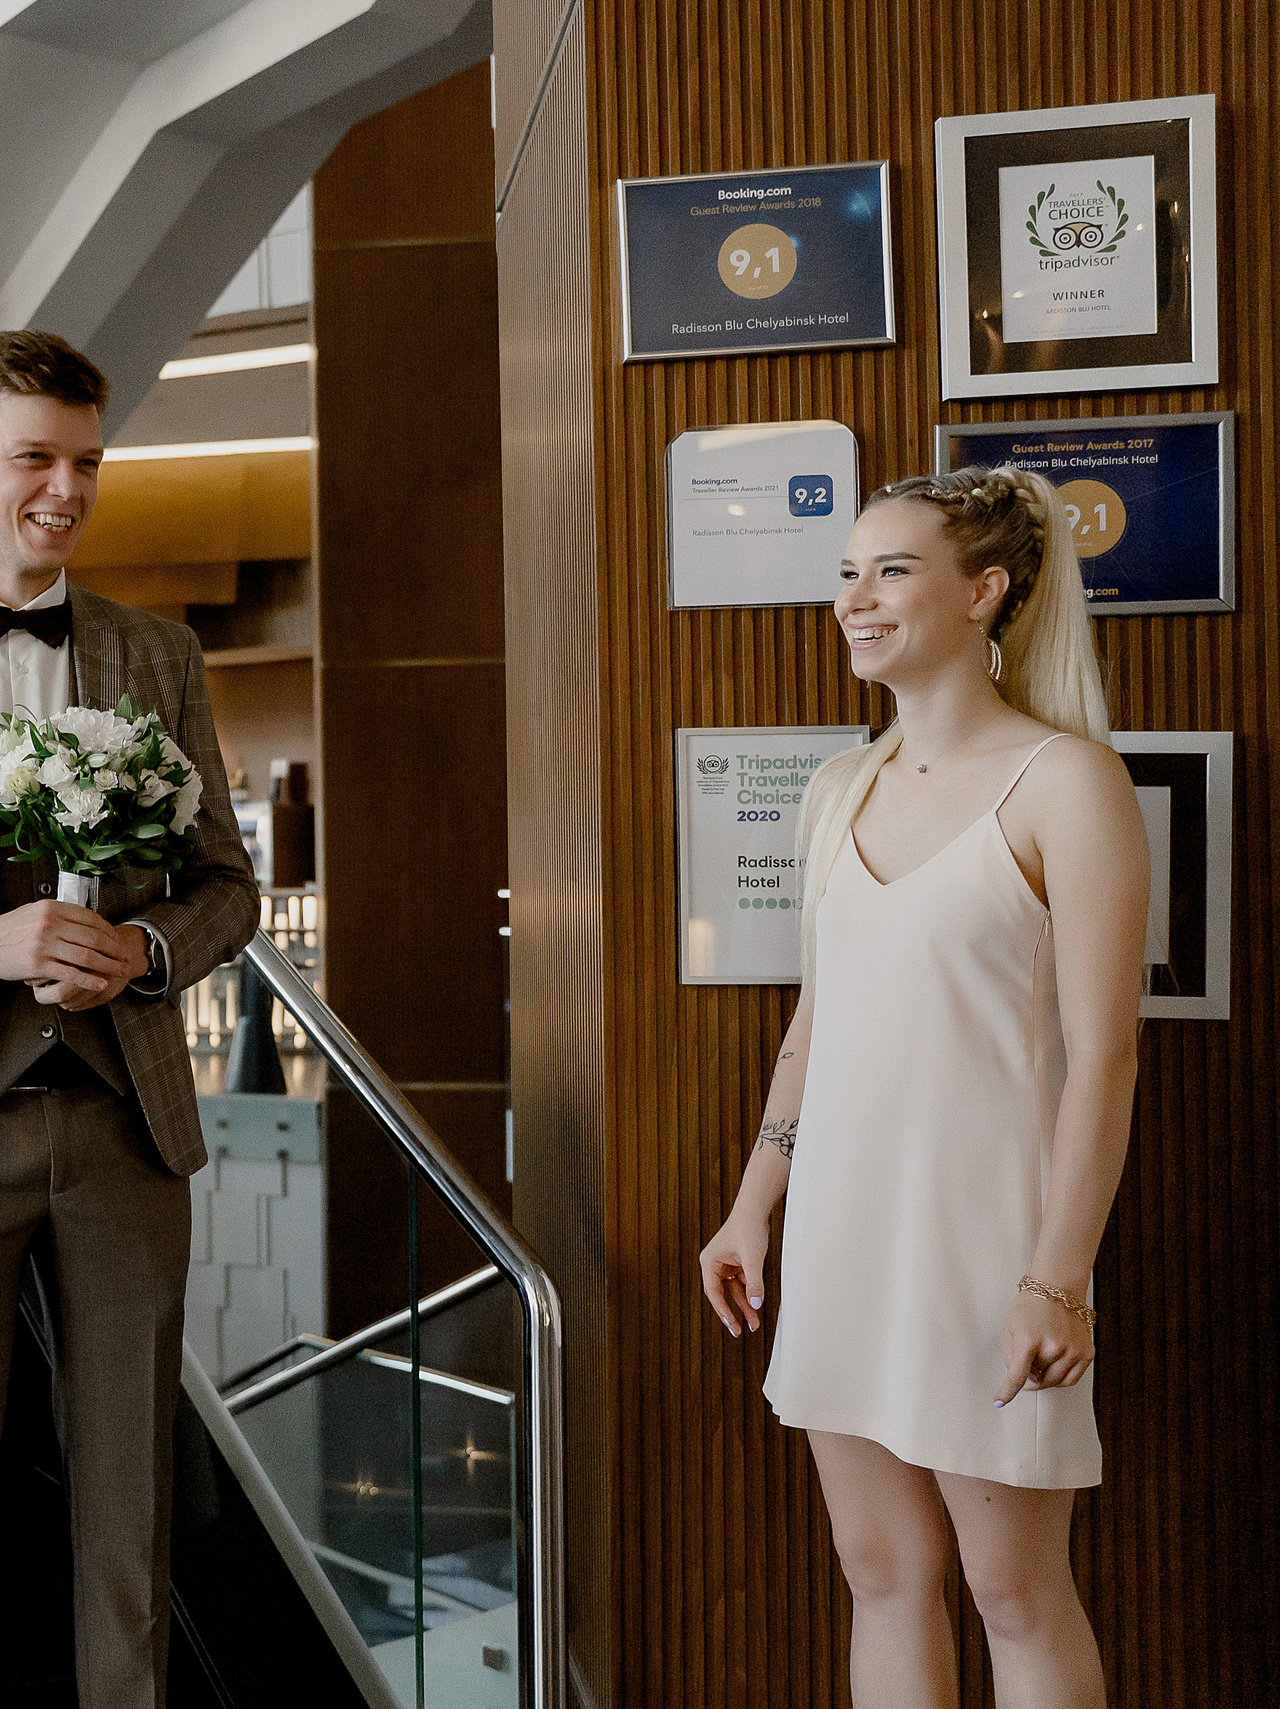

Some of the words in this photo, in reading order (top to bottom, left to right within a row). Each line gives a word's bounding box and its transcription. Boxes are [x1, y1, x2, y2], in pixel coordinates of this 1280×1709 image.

[718, 186, 792, 200] Booking.com
[690, 205, 721, 216] Guest
[722, 203, 756, 213] Review
[759, 200, 796, 210] Awards
[797, 197, 822, 208] 2018
[1048, 206, 1104, 220] CHOICE
[729, 247, 780, 278] 9,1
[1038, 256, 1116, 272] tripadvisor
[1052, 289, 1105, 301] WINNER
[671, 323, 722, 334] Radisson
[725, 320, 743, 331] Blu
[746, 315, 815, 330] Chelyabinsk
[818, 312, 849, 324] Hotel
[1012, 444, 1044, 454] Guest
[1047, 442, 1084, 452] Review
[1086, 440, 1125, 450] Awards
[1127, 438, 1154, 449] 2017
[1005, 459, 1049, 469] Radisson
[1051, 458, 1067, 468] Blu
[1069, 455, 1129, 469] Chelyabinsk
[1131, 454, 1159, 464] Hotel
[691, 478, 738, 486] Booking.com
[795, 487, 827, 505] 9,2
[1065, 503, 1107, 535] 9,1
[692, 529, 724, 537] Radisson
[726, 528, 738, 536] Blu
[739, 526, 783, 535] Chelyabinsk
[736, 753, 823, 773] Tripadvis
[736, 772, 810, 787] Travelle
[737, 789, 802, 805] Choice
[737, 810, 781, 822] 2020
[738, 876, 780, 888] Hotel
